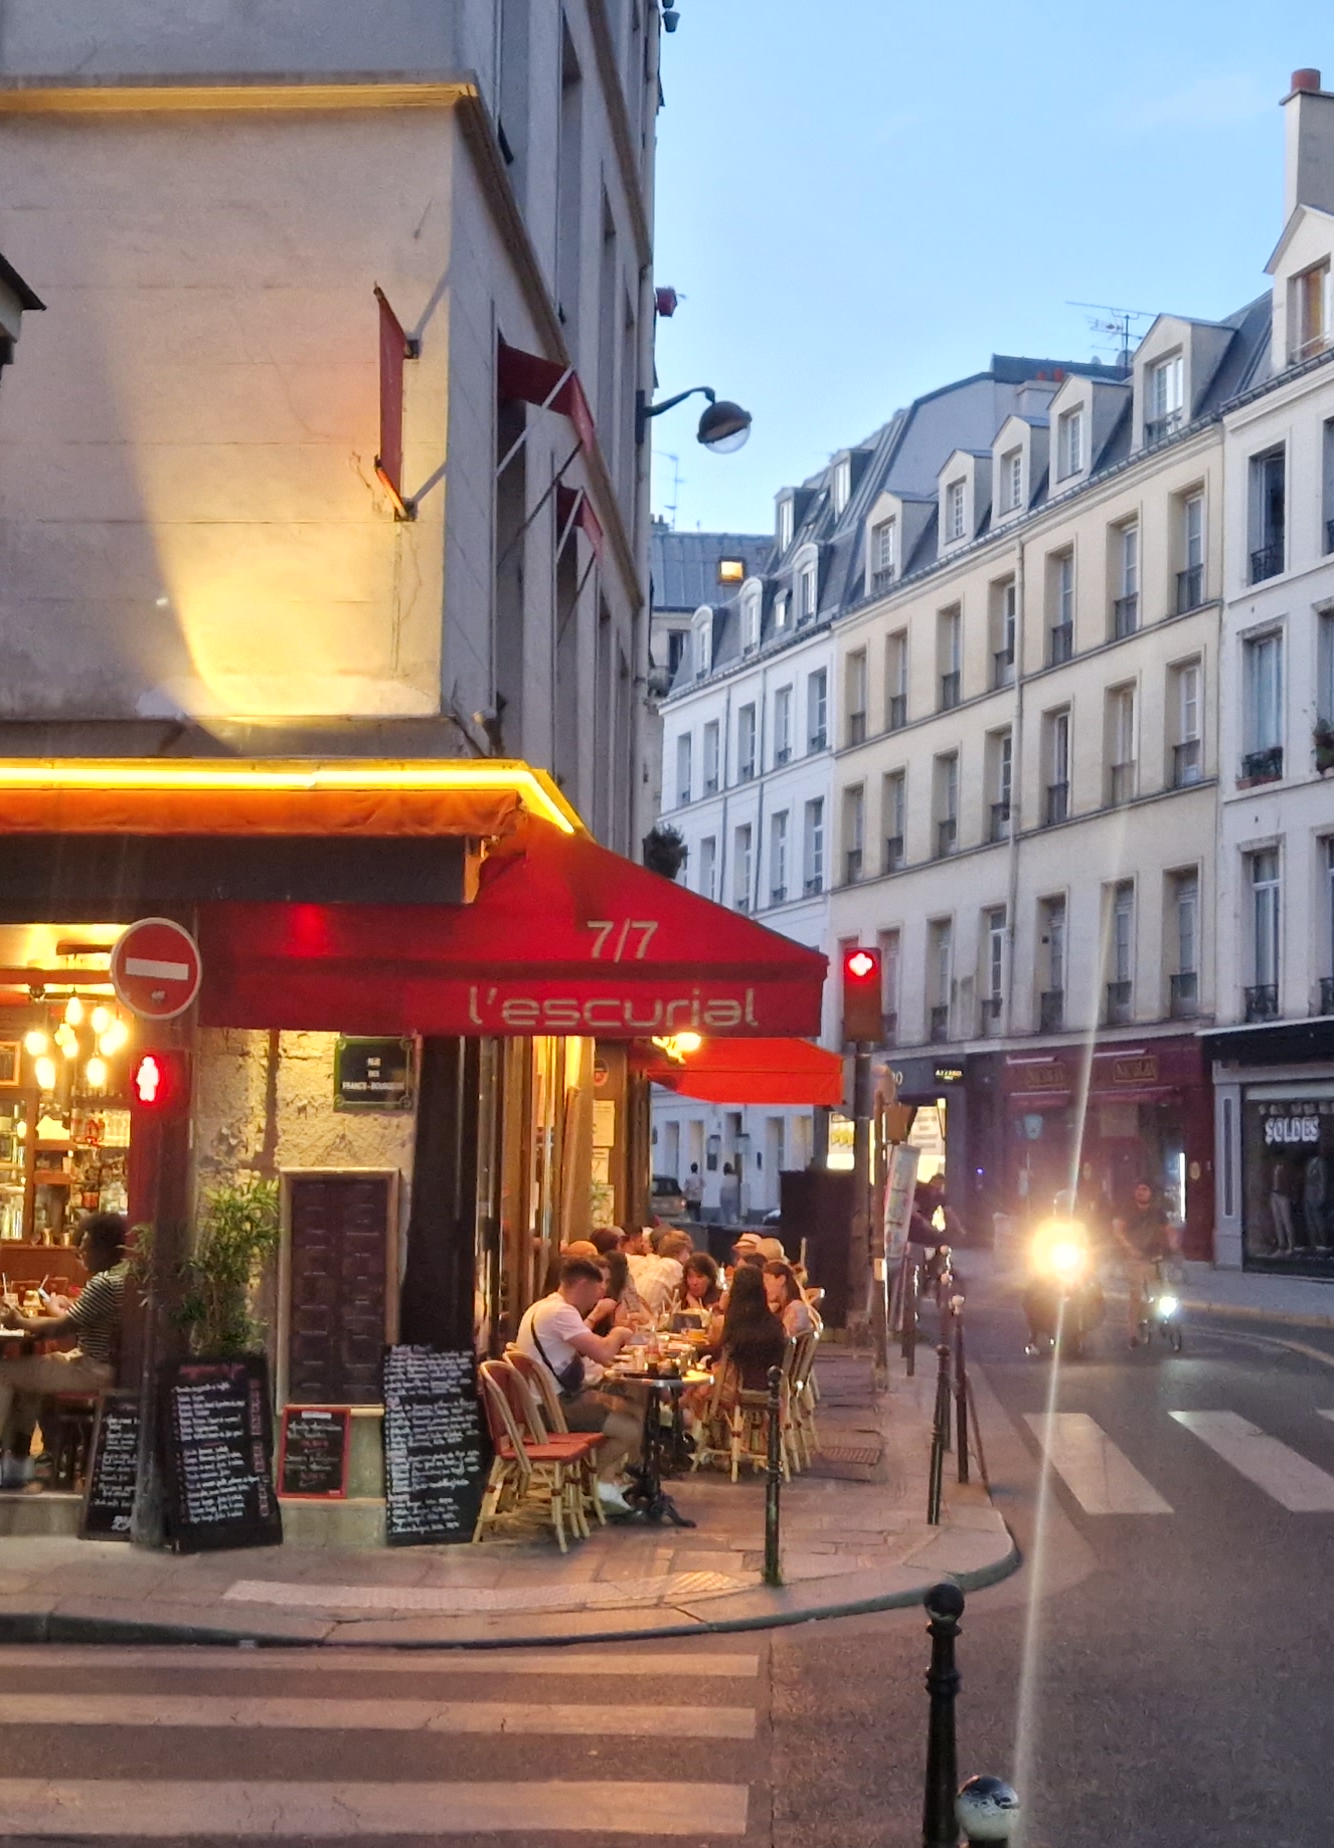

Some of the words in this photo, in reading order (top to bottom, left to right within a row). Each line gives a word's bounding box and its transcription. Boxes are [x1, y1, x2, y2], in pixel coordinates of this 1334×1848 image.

[586, 917, 659, 963] 7/7
[468, 985, 760, 1029] l'escurial
[1264, 1116, 1321, 1146] SOLDES
